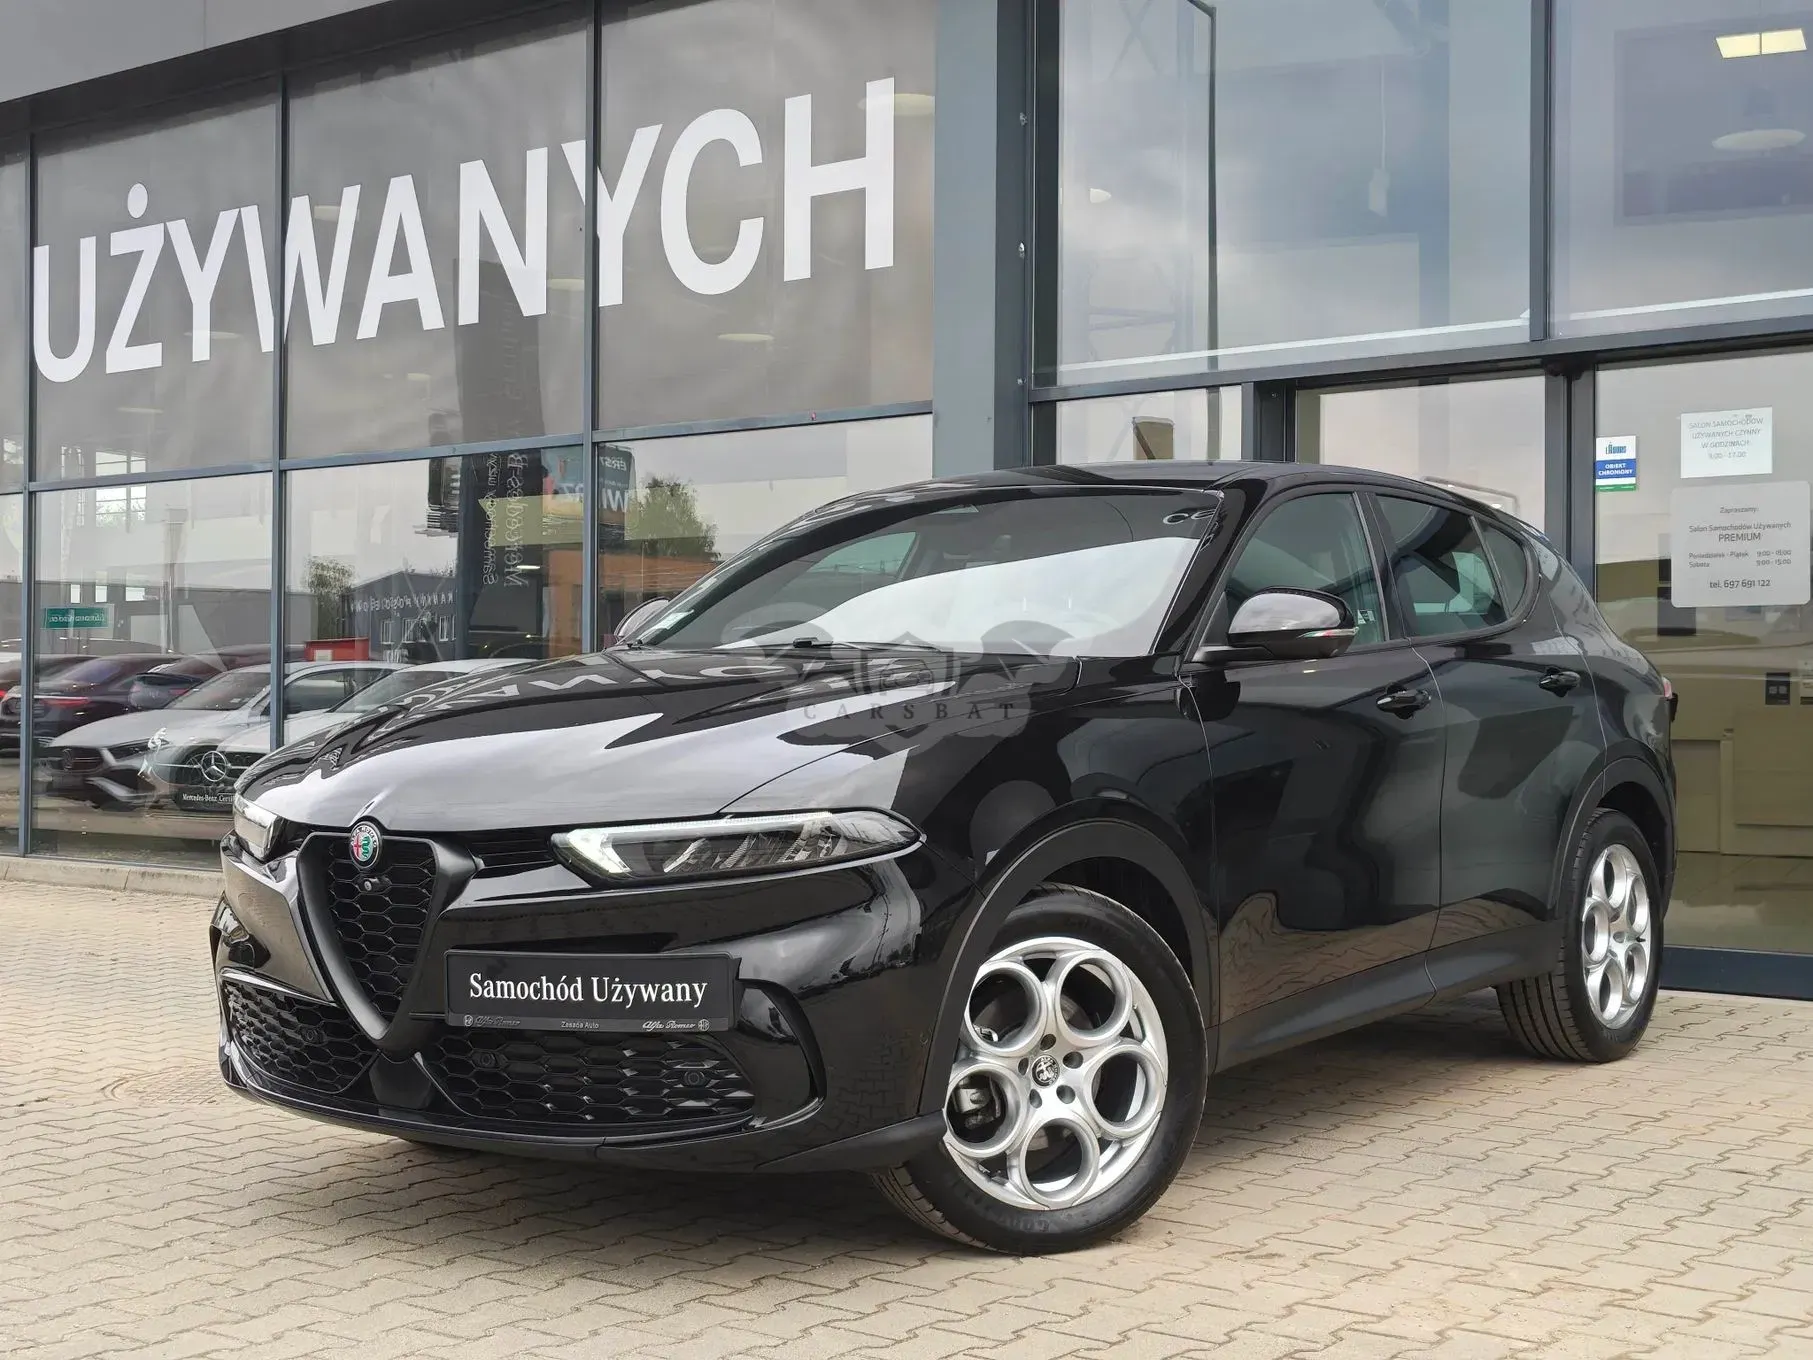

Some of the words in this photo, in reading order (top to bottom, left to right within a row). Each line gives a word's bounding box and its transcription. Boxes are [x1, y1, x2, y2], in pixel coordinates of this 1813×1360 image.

[33, 77, 895, 383] UŻYWANYCH
[1689, 525, 1708, 533] Salon
[1753, 521, 1791, 532] Używanych
[1718, 532, 1761, 542] PREMIUM
[1709, 580, 1722, 589] tel.
[1723, 580, 1740, 589] 697
[1741, 579, 1756, 588] 691
[1757, 579, 1771, 588] 122
[469, 972, 584, 1002] Samochód
[592, 976, 708, 1008] Używany
[642, 1022, 664, 1031] Alfa
